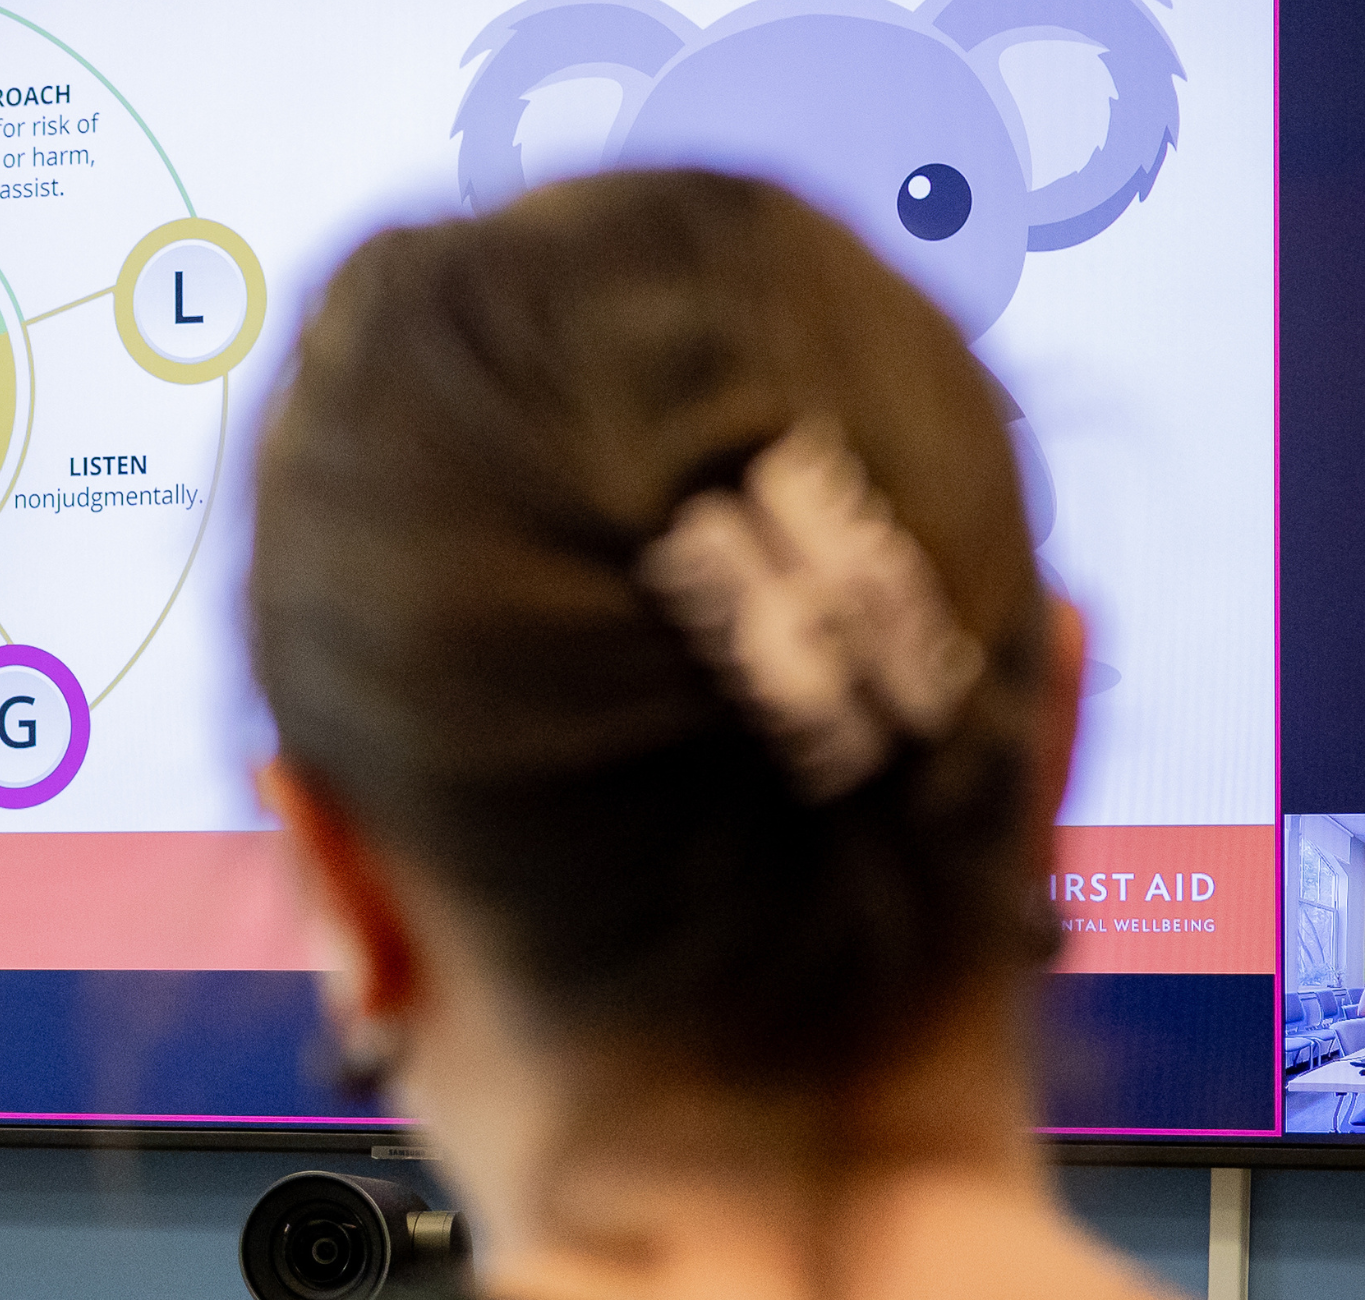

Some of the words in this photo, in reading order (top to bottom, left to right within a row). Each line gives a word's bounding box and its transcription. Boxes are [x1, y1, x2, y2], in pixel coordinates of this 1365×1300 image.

[33, 114, 70, 137] risk
[77, 112, 100, 134] of
[3, 151, 26, 169] or
[33, 146, 95, 167] harm,
[0, 179, 64, 200] assist.
[174, 270, 204, 325] L
[70, 455, 147, 477] LISTEN
[15, 483, 203, 514] nonjudgmentally.
[1049, 873, 1136, 902] IRST
[1144, 873, 1216, 902] AID
[1061, 918, 1108, 933] NTAL
[1113, 918, 1217, 933] WELLBEING
